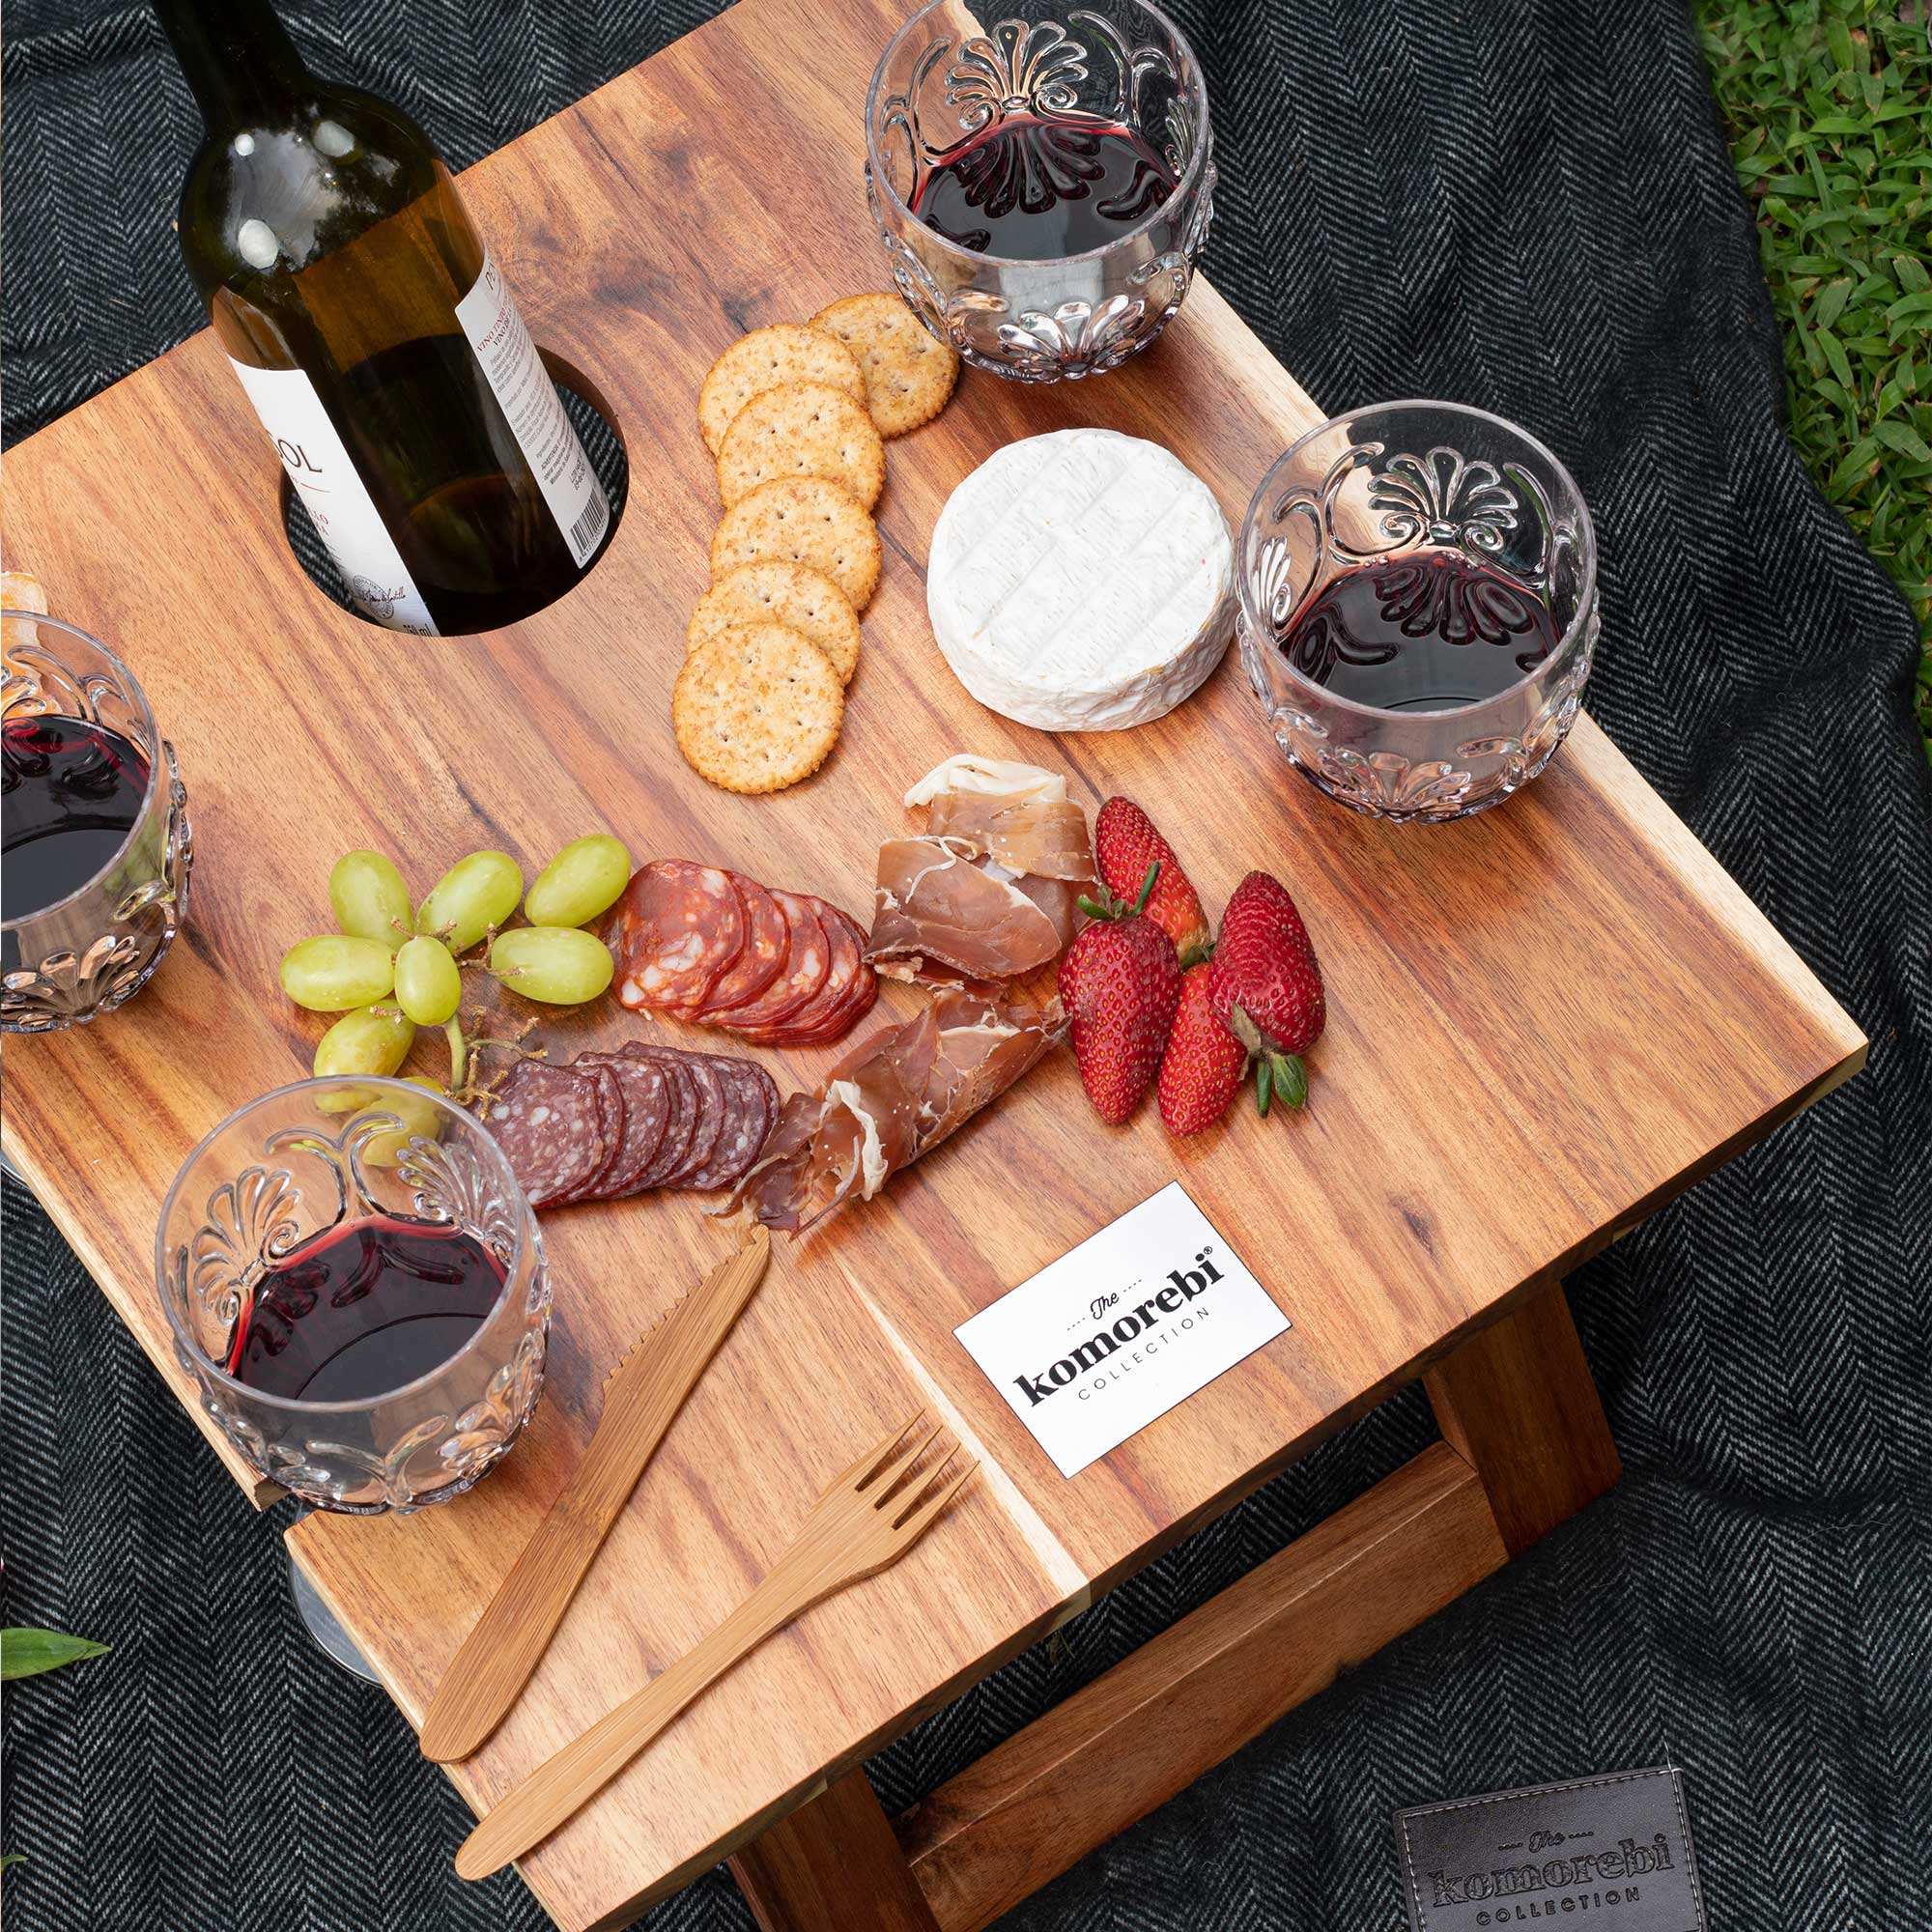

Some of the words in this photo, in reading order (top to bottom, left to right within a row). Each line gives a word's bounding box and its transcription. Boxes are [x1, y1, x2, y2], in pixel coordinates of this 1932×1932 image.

[477, 330, 495, 352] VINO
[494, 327, 506, 346] VINO
[1090, 1292, 1120, 1321] The
[1078, 1307, 1209, 1401] COLLECTION
[1528, 1830, 1568, 1854] The
[1428, 1833, 1675, 1908] komorebi
[1476, 1887, 1640, 1926] COLLECTION
